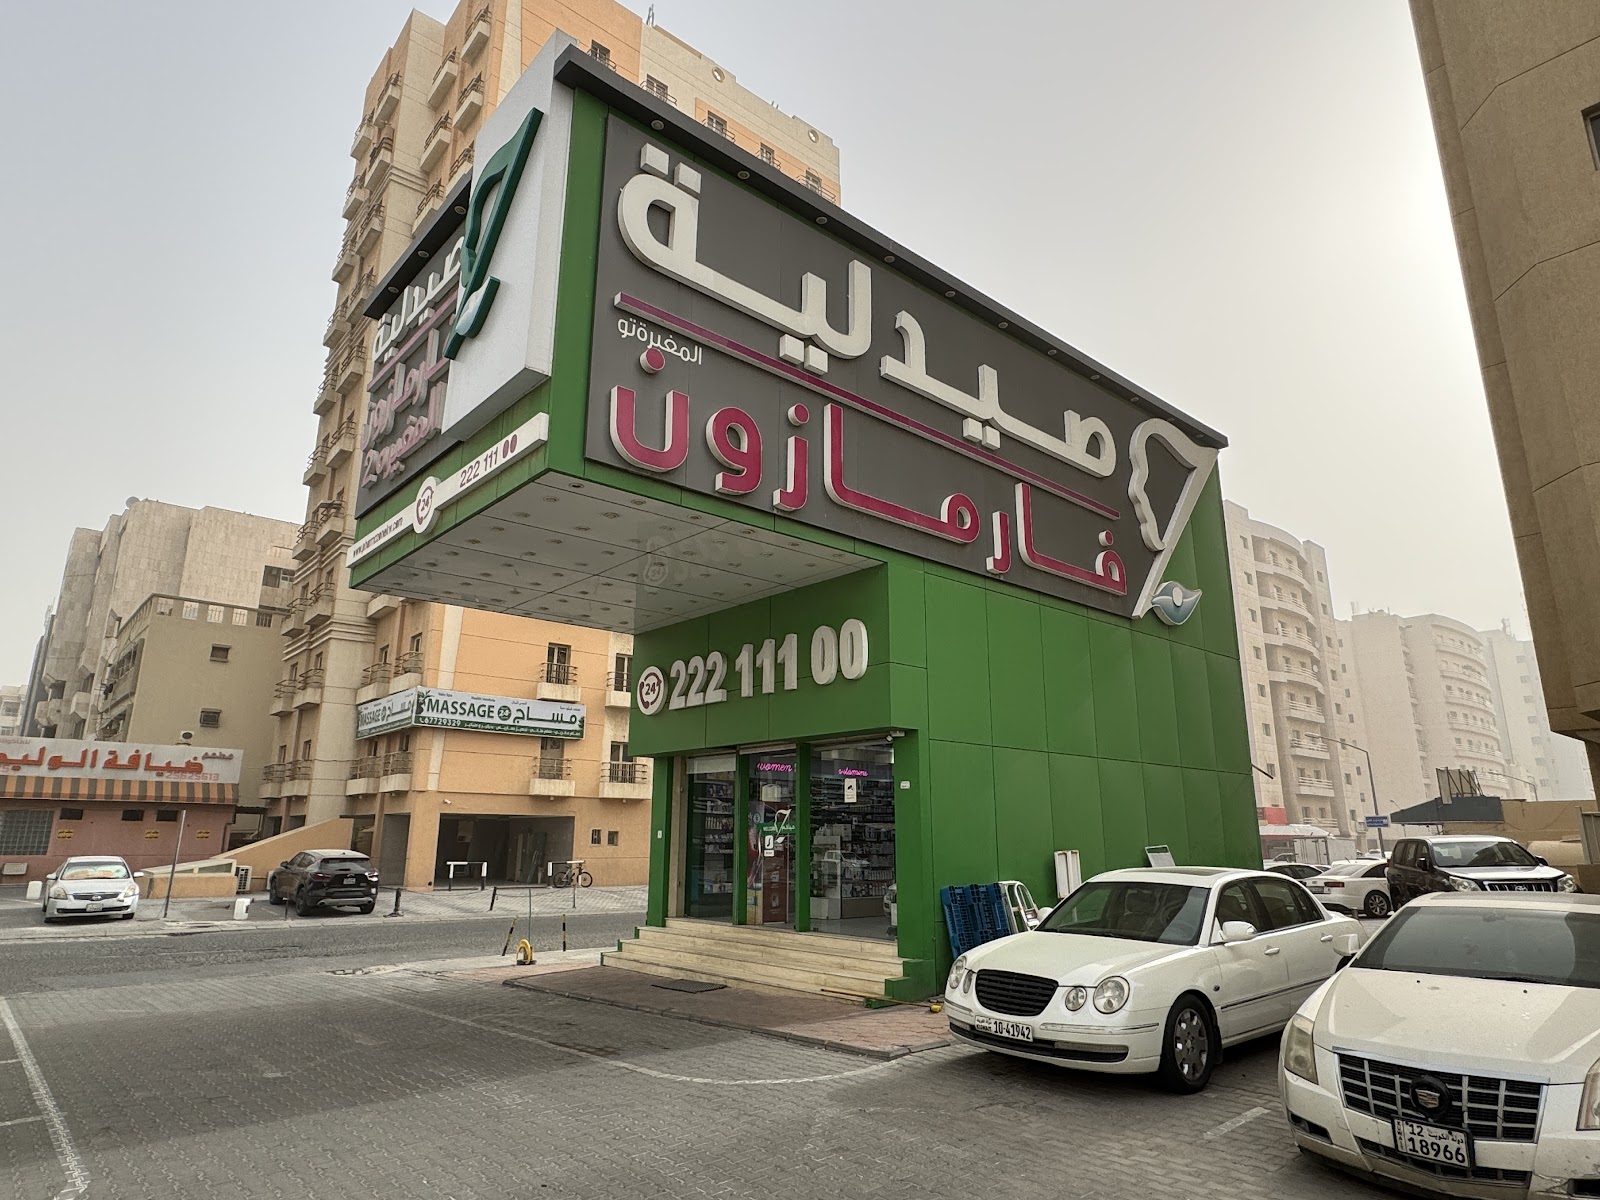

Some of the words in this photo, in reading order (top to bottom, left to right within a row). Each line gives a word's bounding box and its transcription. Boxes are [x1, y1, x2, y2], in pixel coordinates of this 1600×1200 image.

[617, 143, 1117, 478] صيدلية
[460, 460, 480, 488] 222
[484, 446, 499, 472] 111
[502, 434, 518, 459] 00
[609, 349, 1128, 597] فارمازون
[420, 495, 430, 512] 24
[669, 651, 727, 710] 222
[735, 633, 798, 698] 111
[811, 619, 869, 686] 00
[645, 682, 656, 695] 24
[360, 707, 382, 727] MASSAGE
[426, 698, 495, 719] MASSAGE
[513, 706, 577, 724] مساج
[103, 749, 203, 777] ضيافة
[202, 752, 234, 760] مطعم
[757, 762, 793, 772] women
[993, 1021, 1031, 1040] 10-41942
[1409, 1123, 1424, 1137] 12
[1408, 1137, 1466, 1163] 18966
